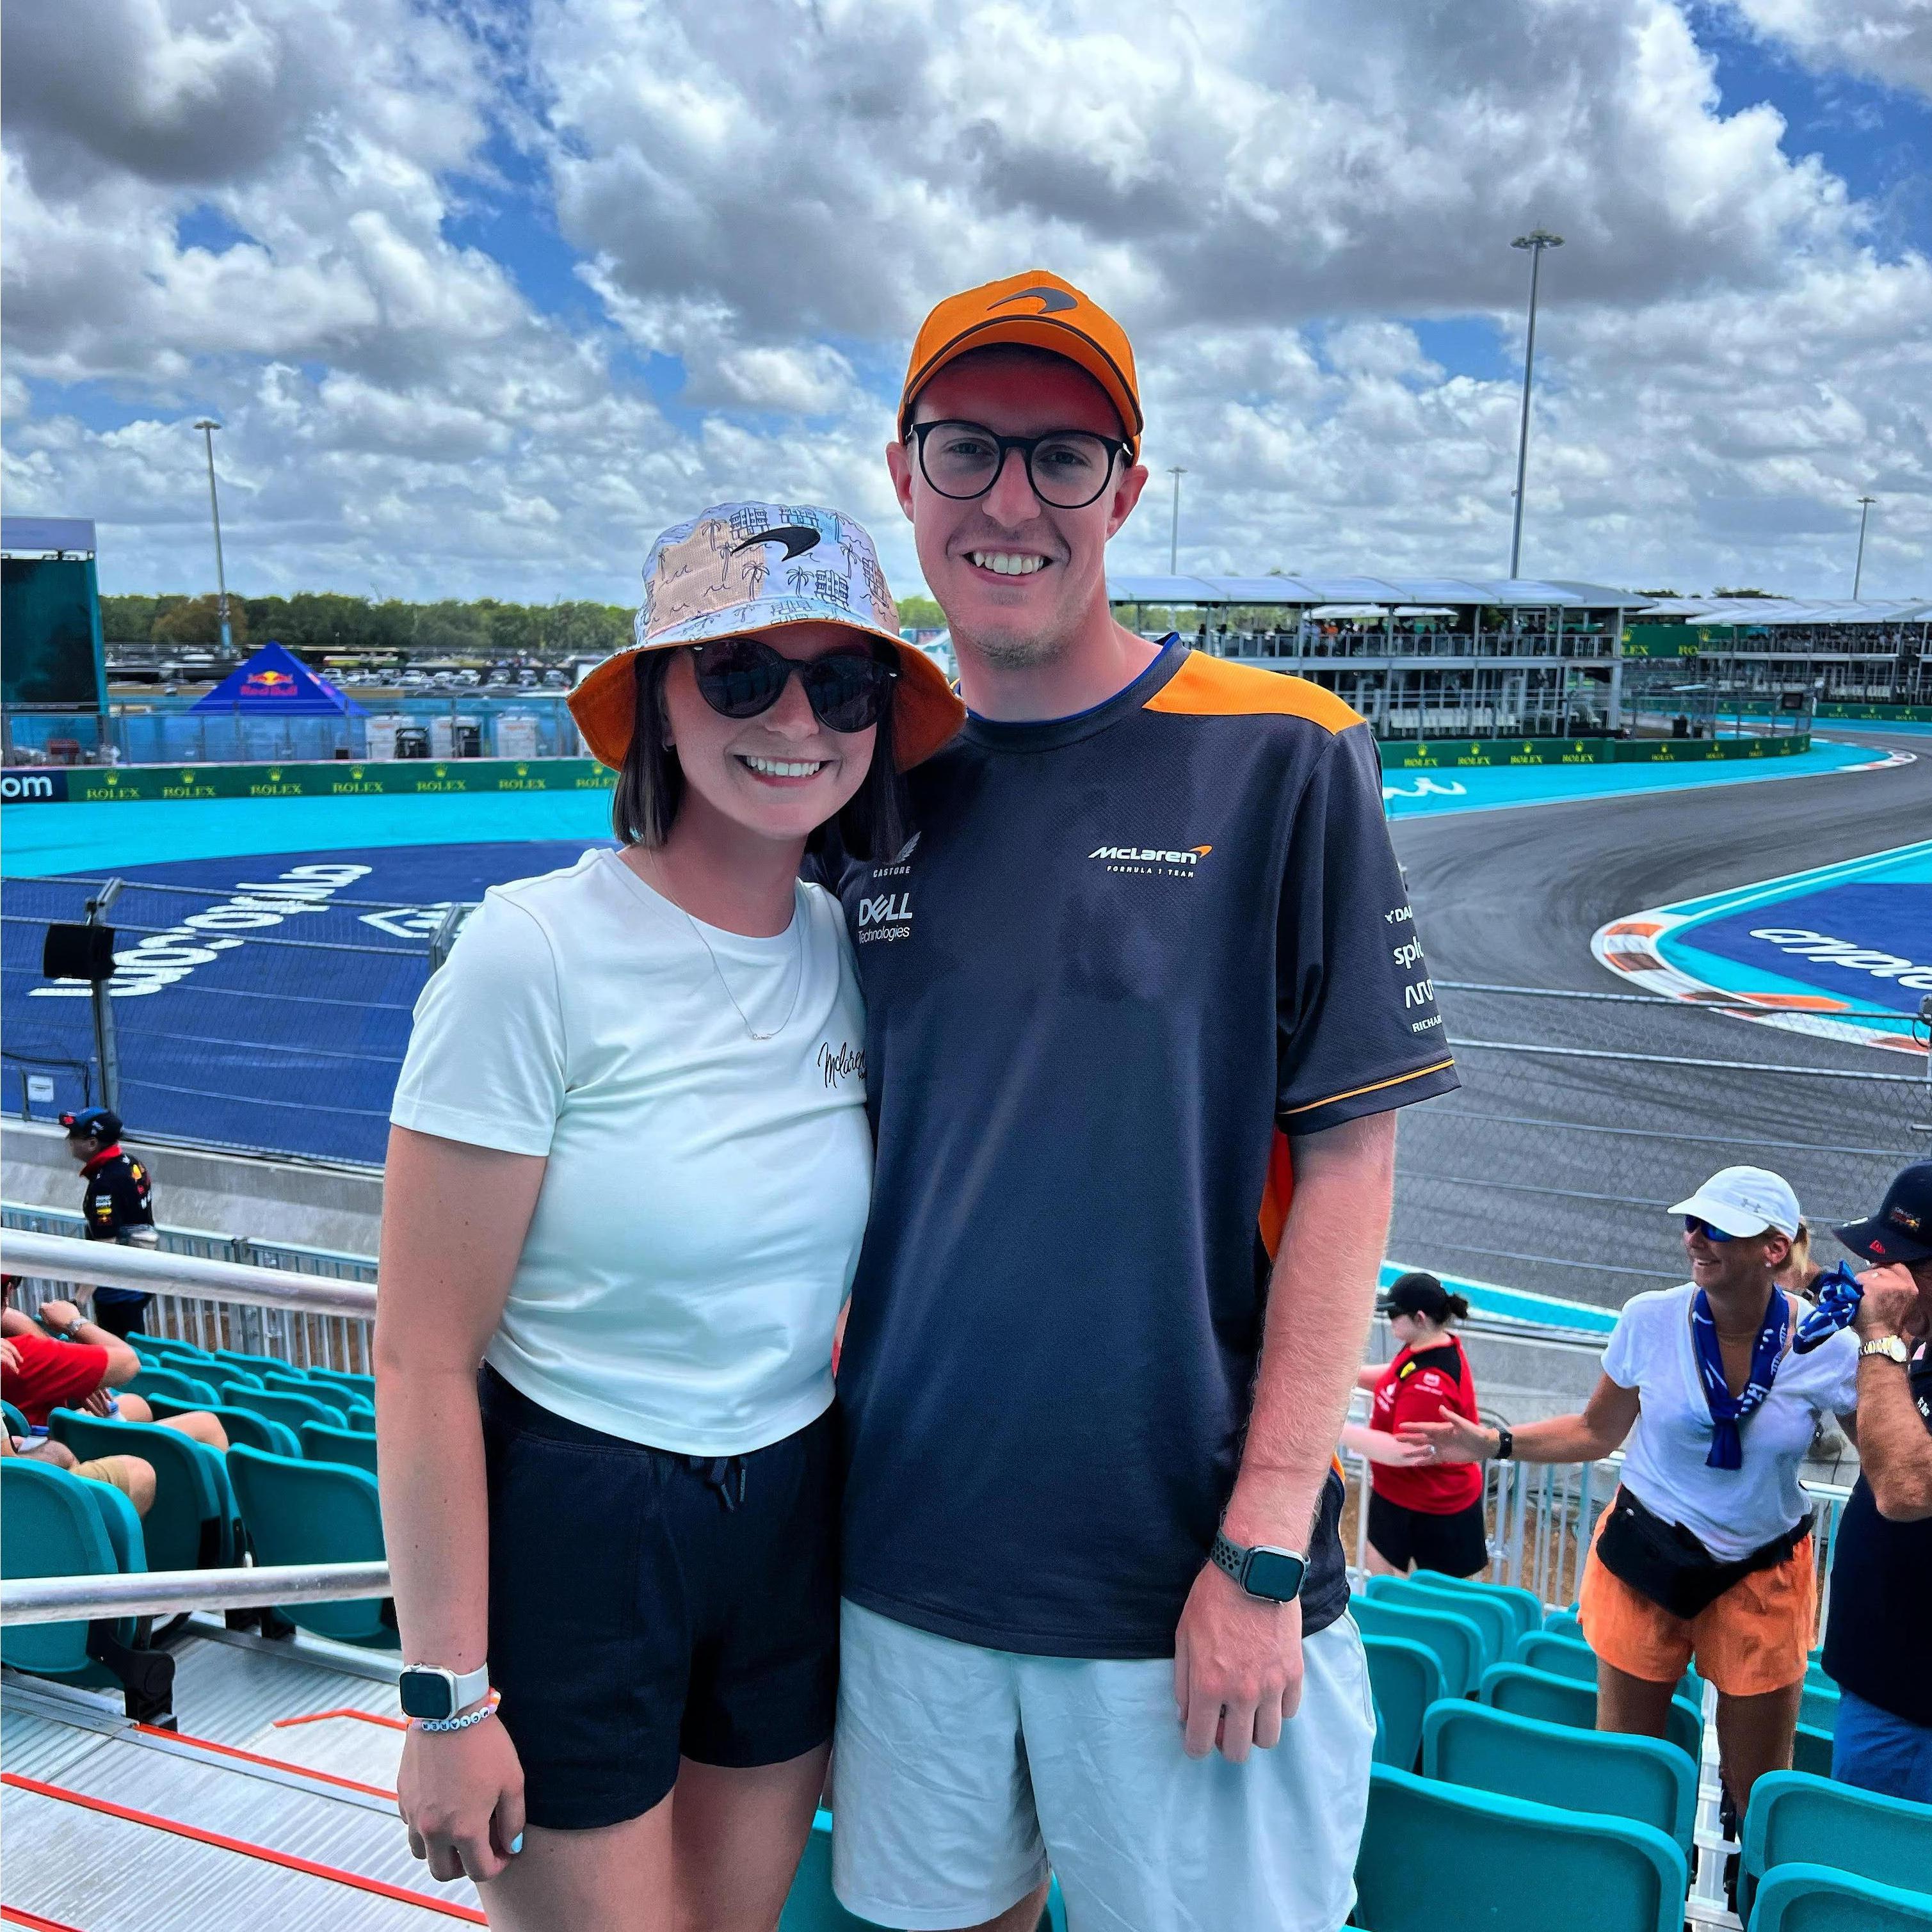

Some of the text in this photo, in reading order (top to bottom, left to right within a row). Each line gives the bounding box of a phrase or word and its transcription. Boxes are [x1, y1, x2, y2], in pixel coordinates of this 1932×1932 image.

[1404, 758, 1438, 768] ROLEX
[1457, 756, 1491, 766] ROLEX
[1510, 755, 1543, 765] ROLEX
[1562, 753, 1595, 764] ROLEX
[1, 776, 53, 798] om
[250, 783, 303, 796] ROLEX
[332, 781, 383, 793] ROLEX
[416, 779, 467, 792] ROLEX
[498, 778, 546, 789] ROLEX
[86, 787, 140, 800] ROLEX
[163, 785, 216, 798] ROLEX
[1088, 846, 1198, 865] McLaren
[873, 865, 912, 878] CASTORE
[1106, 865, 1152, 874] FORMULA
[1168, 869, 1195, 878] TEAM
[858, 892, 913, 926] DELL
[858, 924, 910, 944] Technologies
